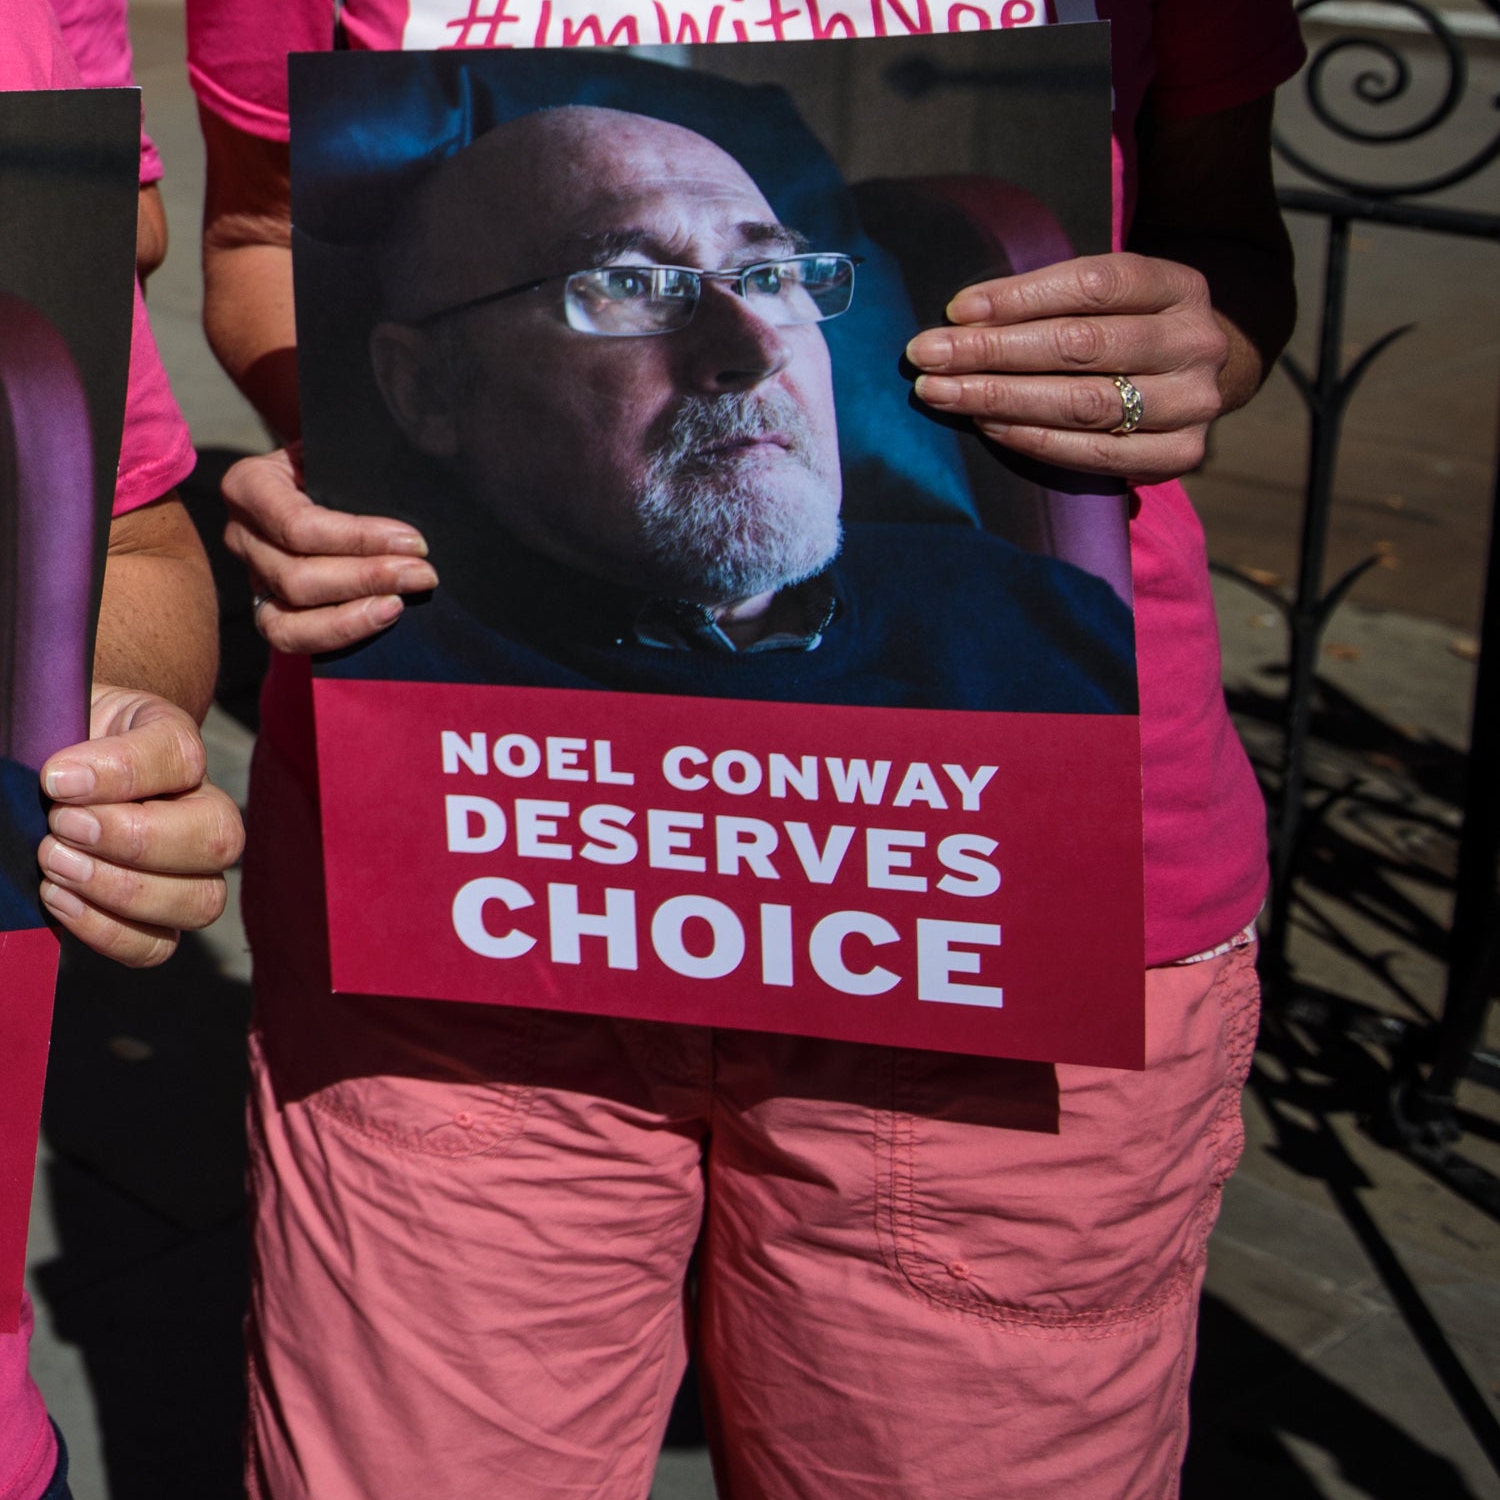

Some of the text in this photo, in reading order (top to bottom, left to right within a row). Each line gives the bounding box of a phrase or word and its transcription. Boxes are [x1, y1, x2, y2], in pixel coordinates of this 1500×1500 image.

[441, 731, 998, 811] NOEL CONWAY
[444, 794, 1001, 898] DESERVES
[451, 876, 1003, 1008] CHOICE
